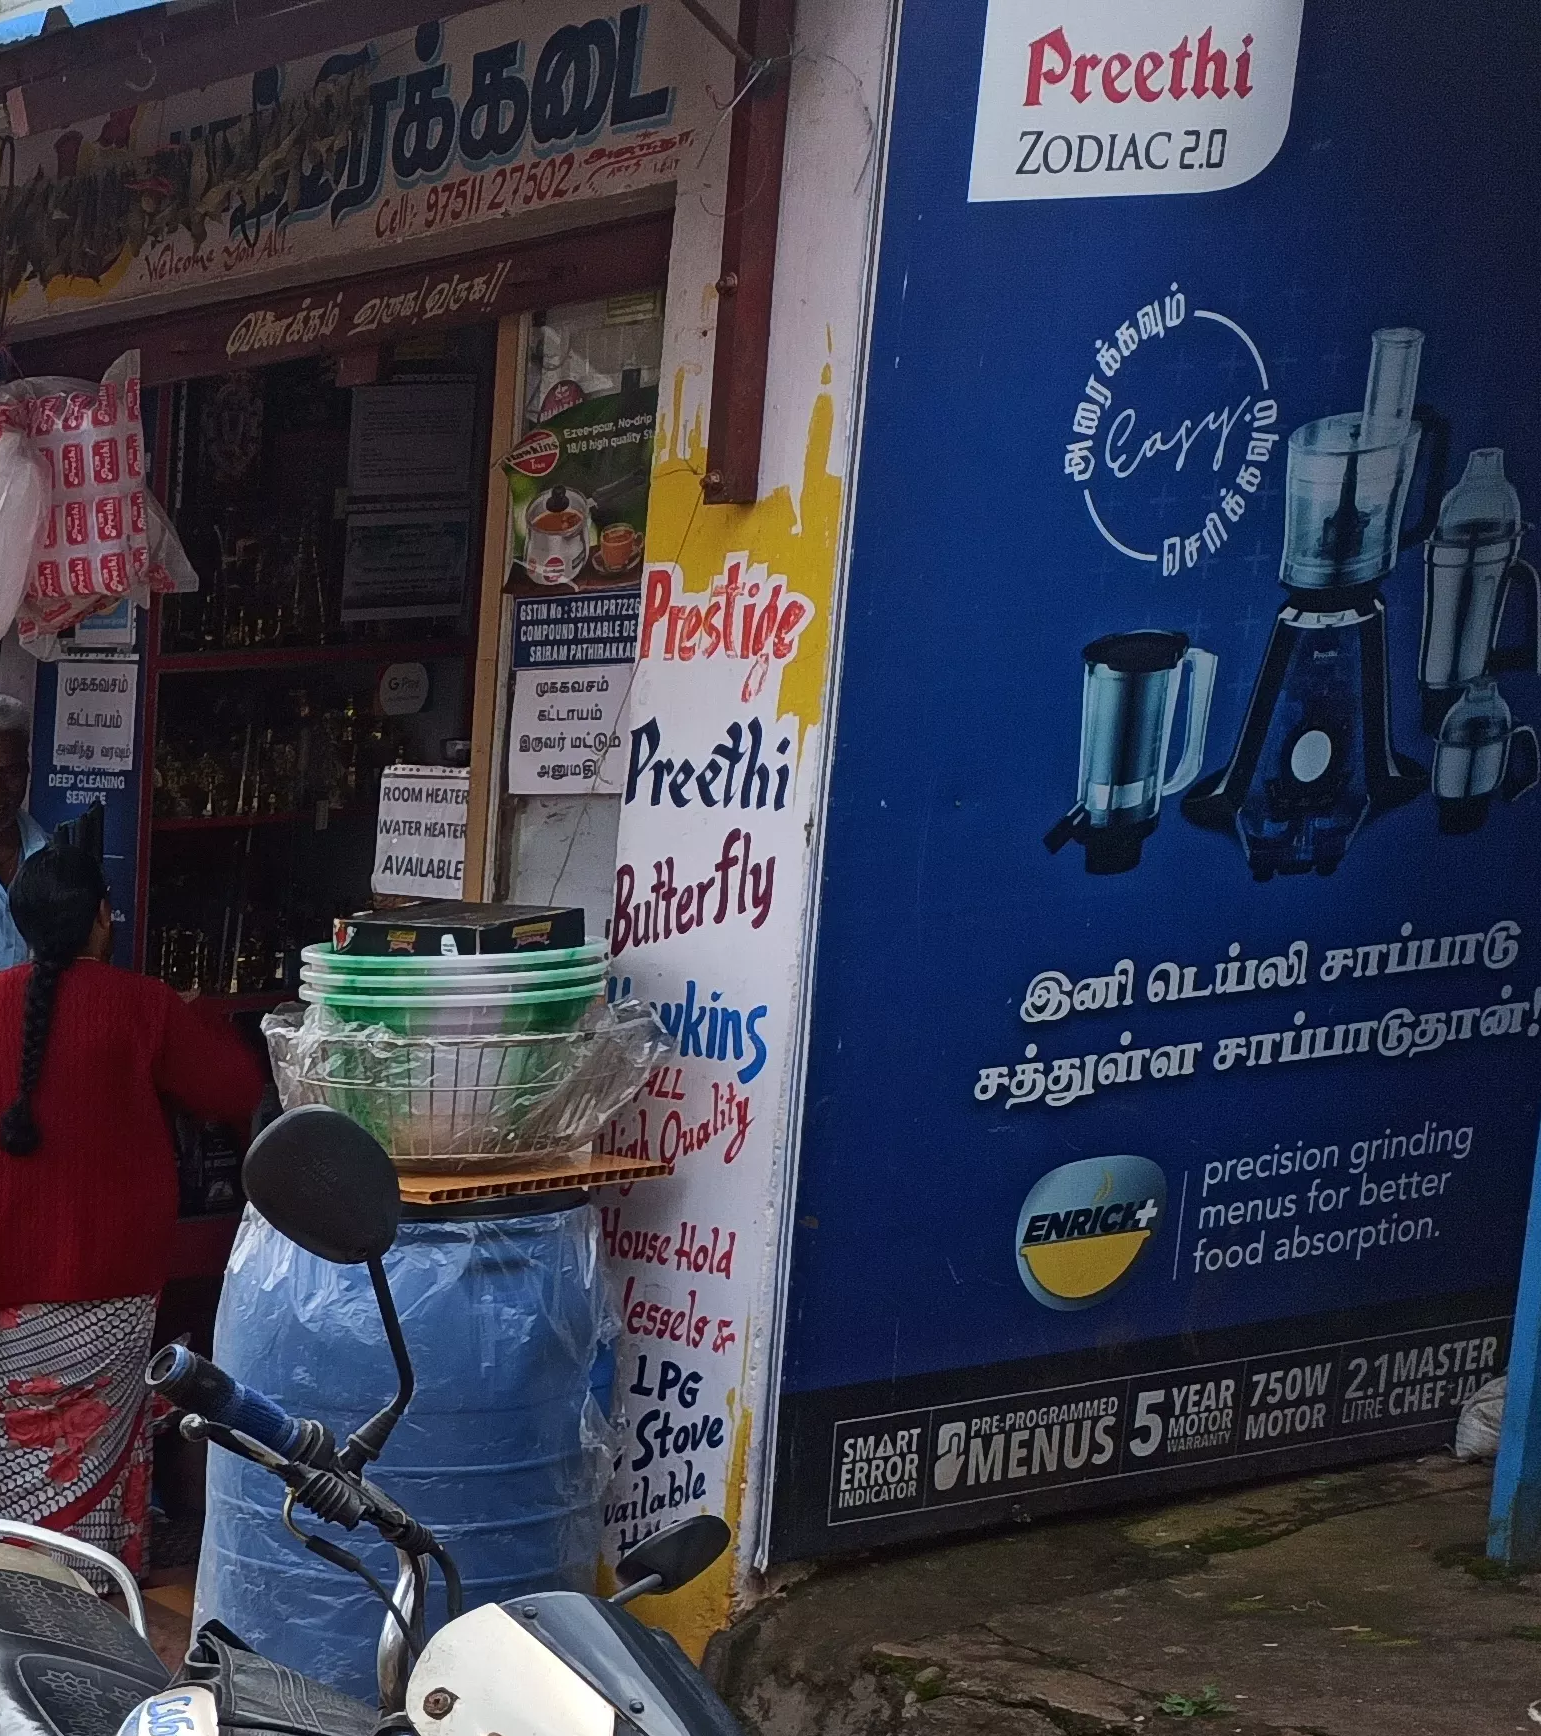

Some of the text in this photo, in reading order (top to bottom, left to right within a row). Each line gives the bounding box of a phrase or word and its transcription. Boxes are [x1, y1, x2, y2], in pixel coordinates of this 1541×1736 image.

[1022, 25, 1256, 107] Preethi
[1015, 129, 1228, 176] ZODIAC 2.0
[425, 179, 483, 229] 97511
[589, 438, 609, 451] high
[610, 432, 642, 446] quality
[1104, 394, 1252, 479] Easy
[520, 603, 548, 621] GSTIN
[520, 622, 574, 642] COMPOUND
[577, 621, 620, 639] TAXABLE
[640, 561, 807, 704] Prestige
[529, 645, 567, 663] SRIRAM
[66, 709, 122, 728] கட்டாயம்
[537, 704, 603, 722] கட்டாயம்
[519, 732, 566, 753] இருவர்
[48, 774, 125, 789] DEEP CLEANING
[536, 759, 598, 780] அனுமதி
[624, 716, 792, 815] Preethi
[66, 791, 106, 805] SERVICE
[383, 786, 422, 803] ROOM
[379, 819, 421, 836] WATER
[382, 855, 463, 880] AVAILABLE
[611, 827, 777, 960] Butterfly
[1020, 919, 1523, 1022] இனி டெய்லி சாப்பாடு
[607, 976, 768, 1085] wkins
[972, 1031, 1202, 1109] சத்துள்ள
[659, 1082, 757, 1176] Quality
[1202, 1121, 1474, 1189] precision grinding
[1197, 1167, 1451, 1230] menus for better
[674, 1221, 737, 1280] Hold
[1192, 1211, 1440, 1273] food absorption.
[629, 1354, 704, 1409] LPG
[1344, 1353, 1389, 1399] 2.1
[1392, 1336, 1497, 1382] MASTER
[1168, 1379, 1235, 1416] YEAR
[1250, 1362, 1332, 1406] 750W
[970, 1397, 1119, 1436] PRE-PROGRAMMED
[1129, 1389, 1165, 1457] 5
[1168, 1409, 1233, 1437] MOTOR
[1245, 1404, 1326, 1441] MOTOR
[1342, 1398, 1383, 1423] LITRE
[631, 1408, 724, 1472] Stove
[967, 1415, 1116, 1485] MENUS
[1167, 1430, 1230, 1453] WARRANTY
[603, 1459, 706, 1527] vailable
[840, 1454, 918, 1490] ERROR
[839, 1482, 916, 1509] INDICATOR
